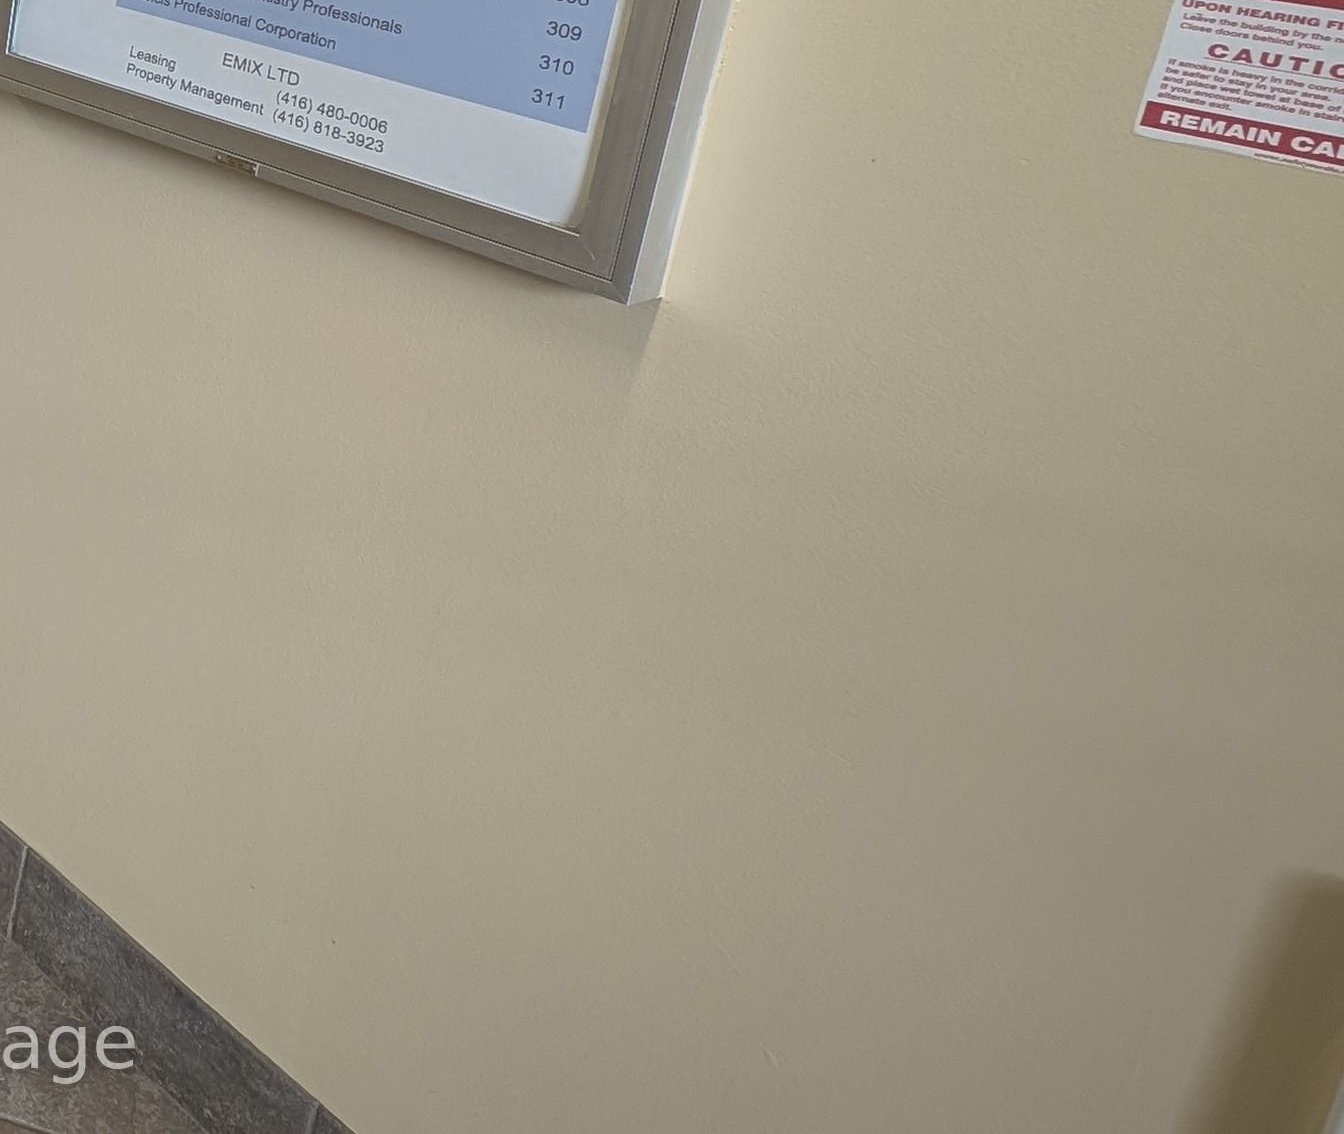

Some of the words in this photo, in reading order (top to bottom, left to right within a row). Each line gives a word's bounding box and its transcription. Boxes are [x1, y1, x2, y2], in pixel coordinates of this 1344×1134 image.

[546, 20, 582, 41] 309
[1236, 8, 1321, 27] HEARING
[255, 18, 336, 50] Corporation
[129, 45, 176, 72] Leasing
[222, 52, 264, 77] EMIX
[266, 64, 300, 86] LTD
[538, 54, 574, 76] 310
[126, 62, 178, 90] Property
[180, 78, 264, 116] Management
[531, 88, 565, 110] 311
[276, 90, 313, 114] (416)
[316, 102, 388, 134] 480-0006
[1159, 110, 1283, 146] REMAIN
[272, 108, 309, 133] (416)
[313, 120, 384, 153] 818-3923
